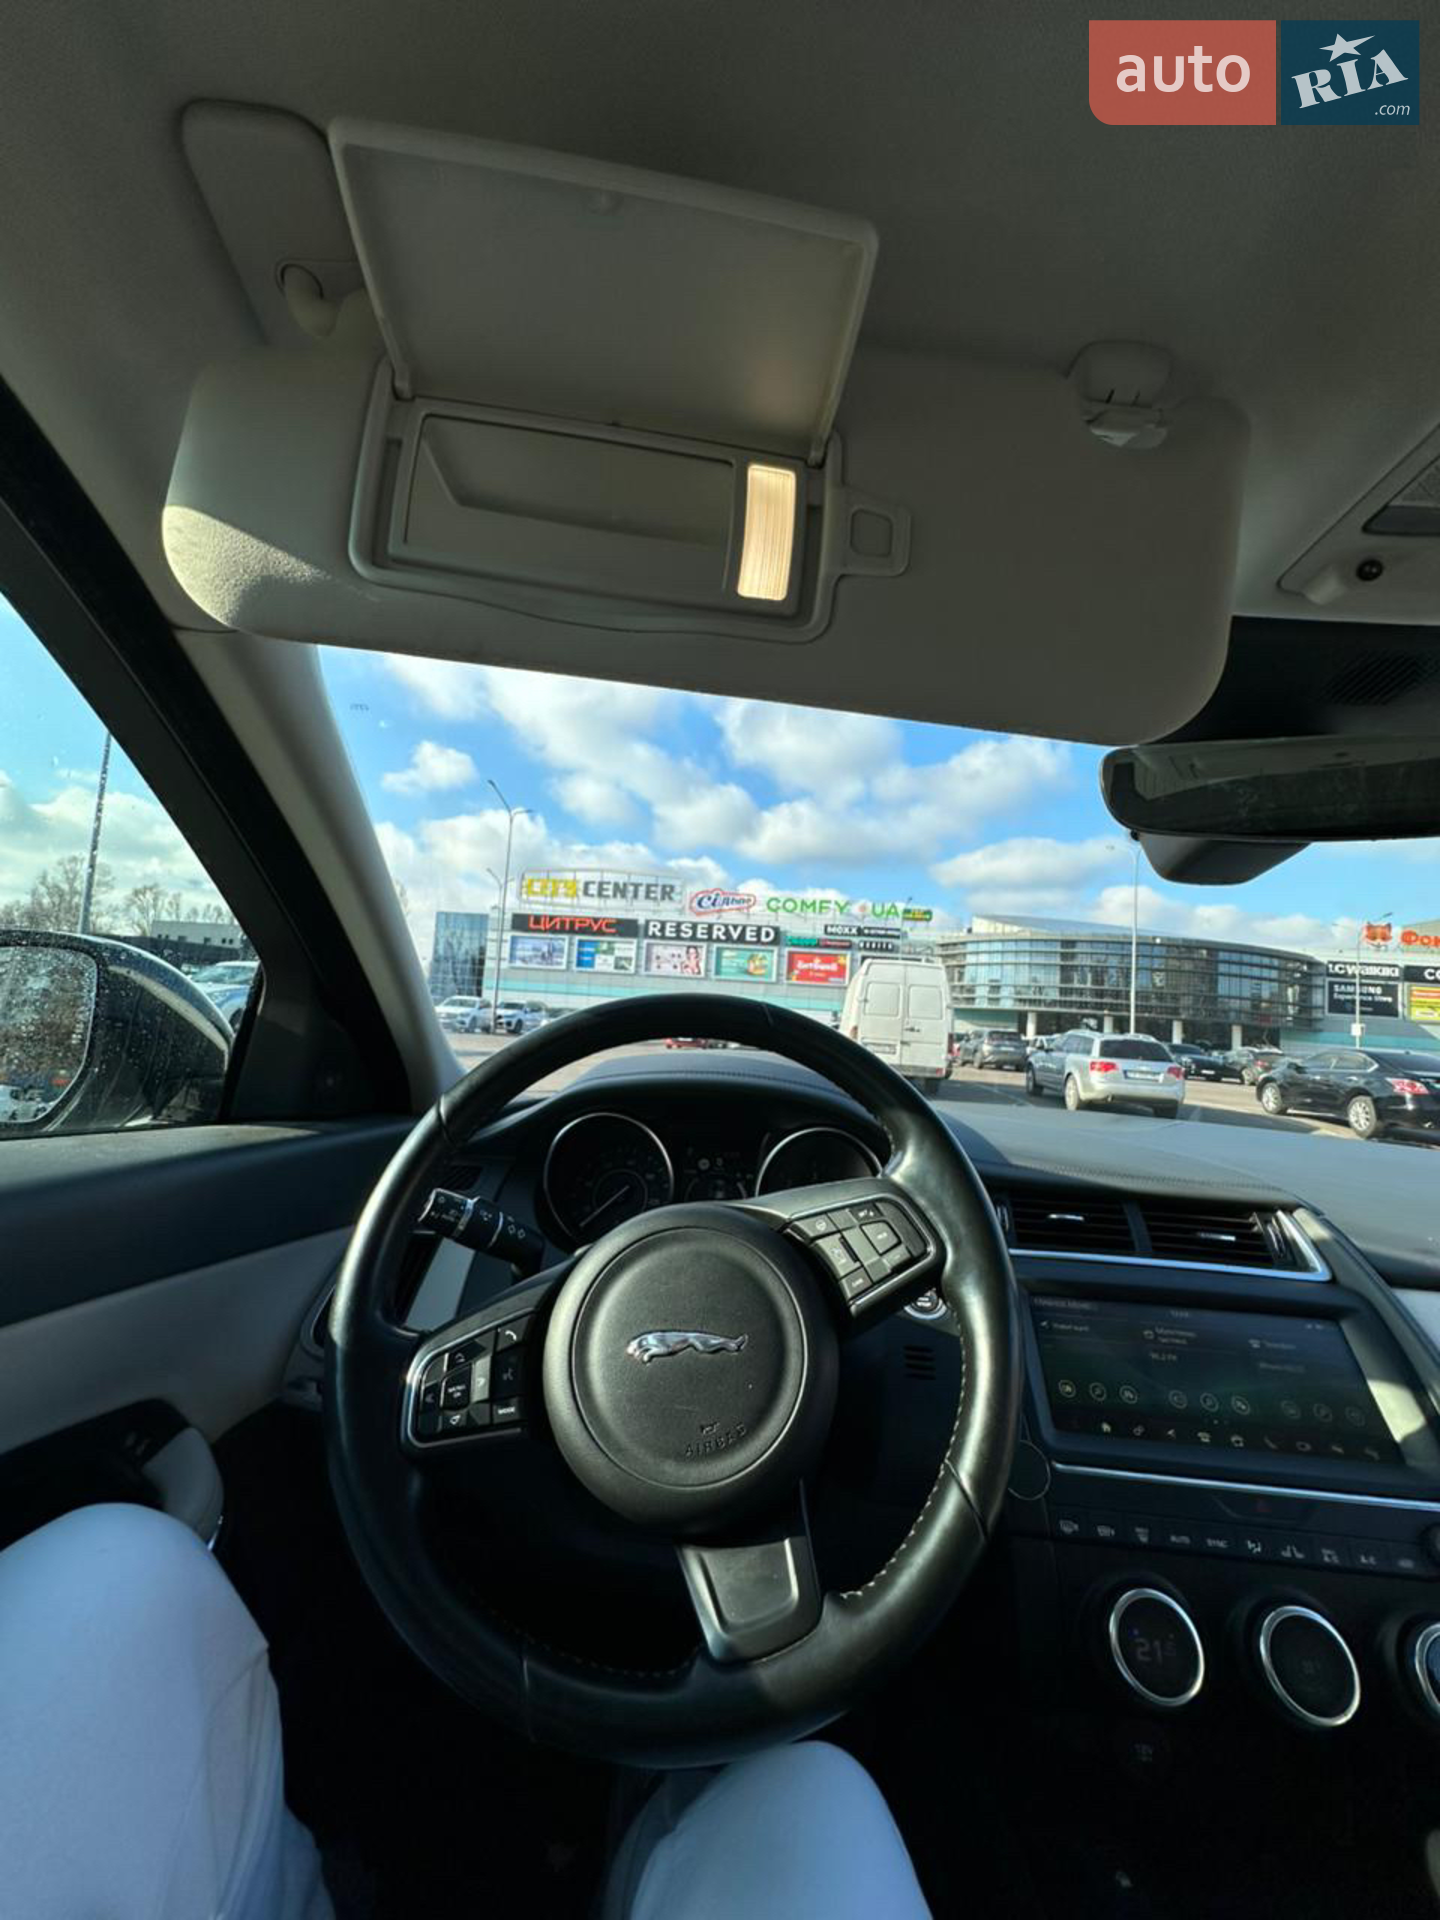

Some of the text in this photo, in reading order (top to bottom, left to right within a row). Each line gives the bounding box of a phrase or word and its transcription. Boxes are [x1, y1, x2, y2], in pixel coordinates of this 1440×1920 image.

[582, 880, 675, 901] CENTER
[766, 897, 849, 914] COMFY
[528, 914, 618, 933] ЦИТРУС
[648, 920, 775, 942] RESERVED
